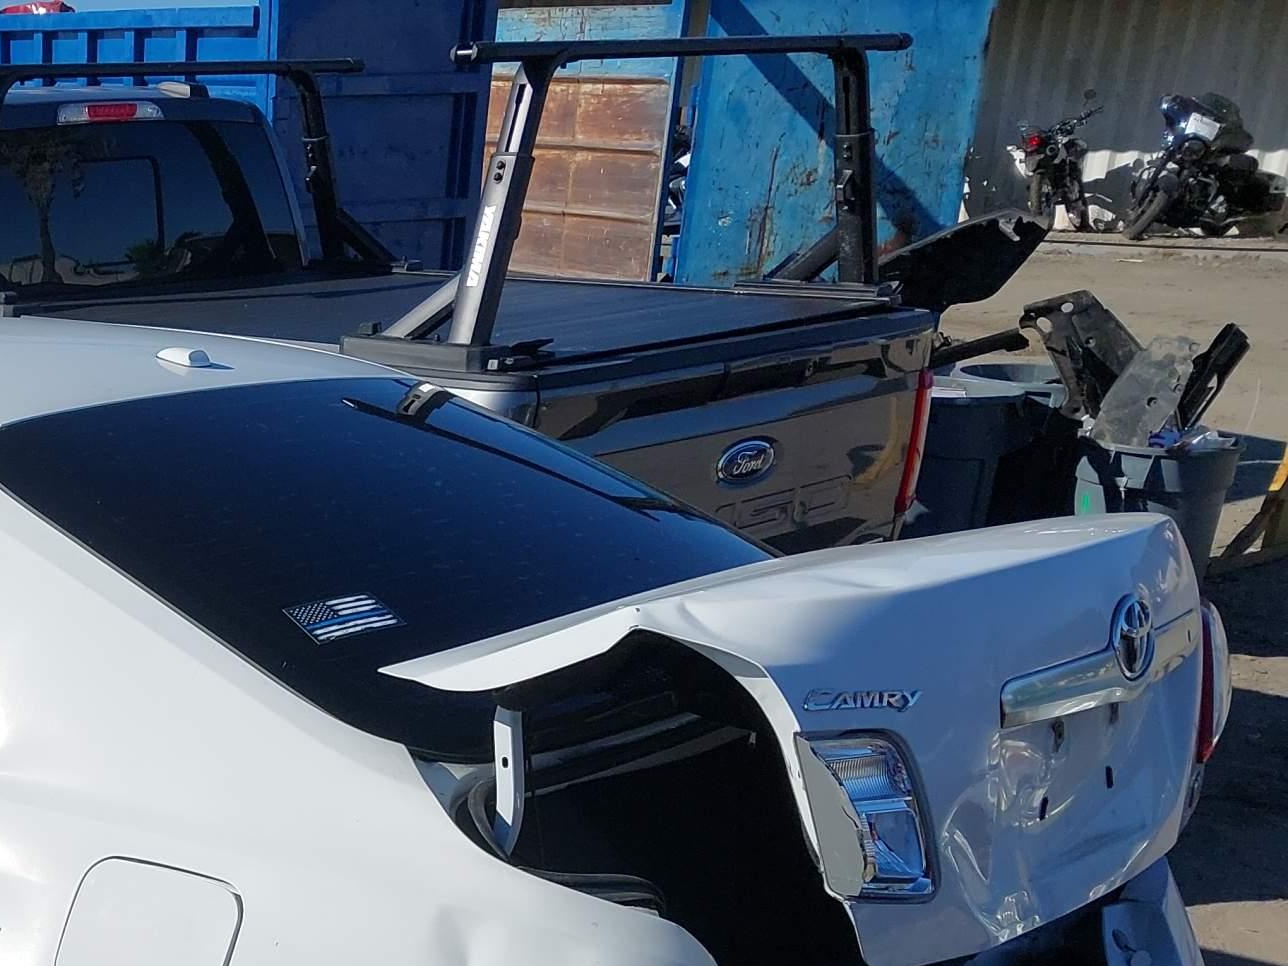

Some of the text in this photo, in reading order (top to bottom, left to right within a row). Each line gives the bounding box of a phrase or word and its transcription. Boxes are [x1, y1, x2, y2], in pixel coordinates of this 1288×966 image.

[466, 205, 497, 287] YAKIMA
[733, 450, 765, 475] Ford
[802, 688, 922, 712] CAMRY
